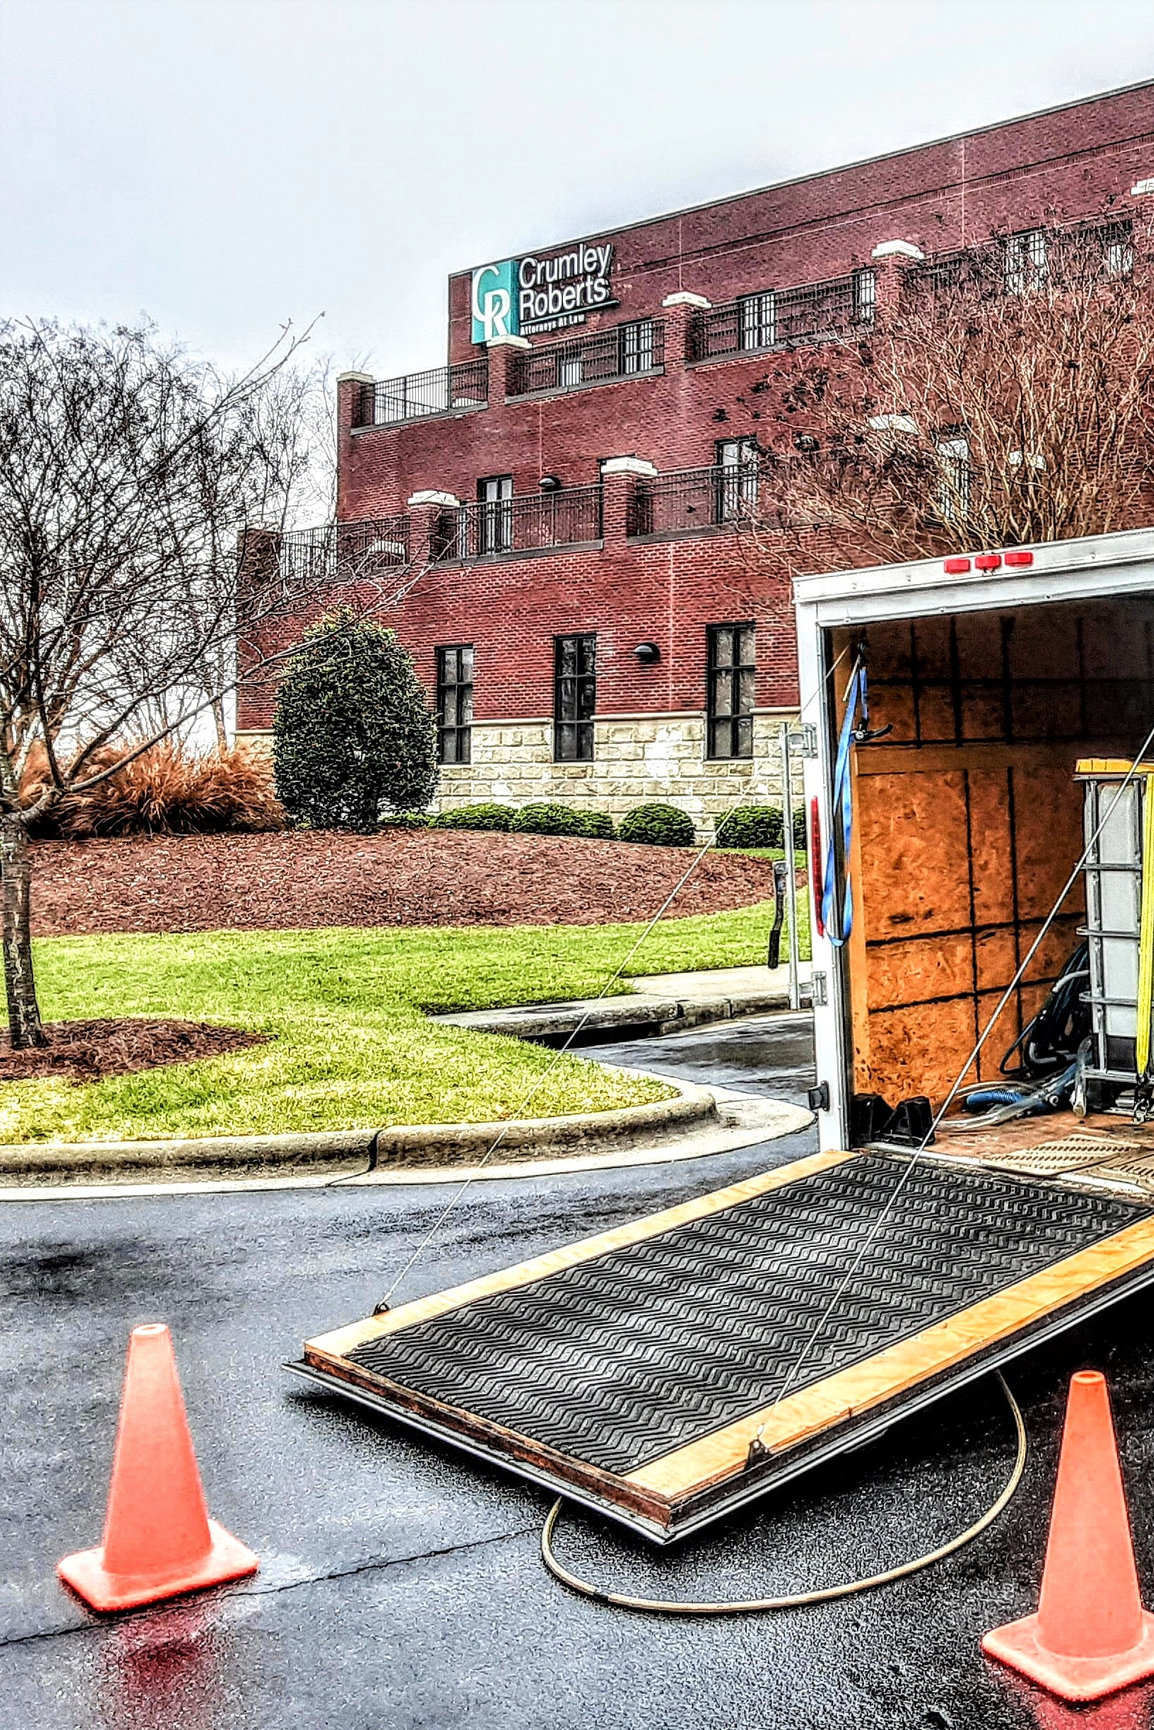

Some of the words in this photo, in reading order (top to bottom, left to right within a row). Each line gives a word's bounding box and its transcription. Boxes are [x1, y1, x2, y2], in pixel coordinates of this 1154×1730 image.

[519, 243, 611, 289] Crumley
[519, 276, 610, 320] Roberts
[520, 321, 557, 336] Attorneys
[558, 315, 567, 327] At
[569, 313, 585, 325] Law
